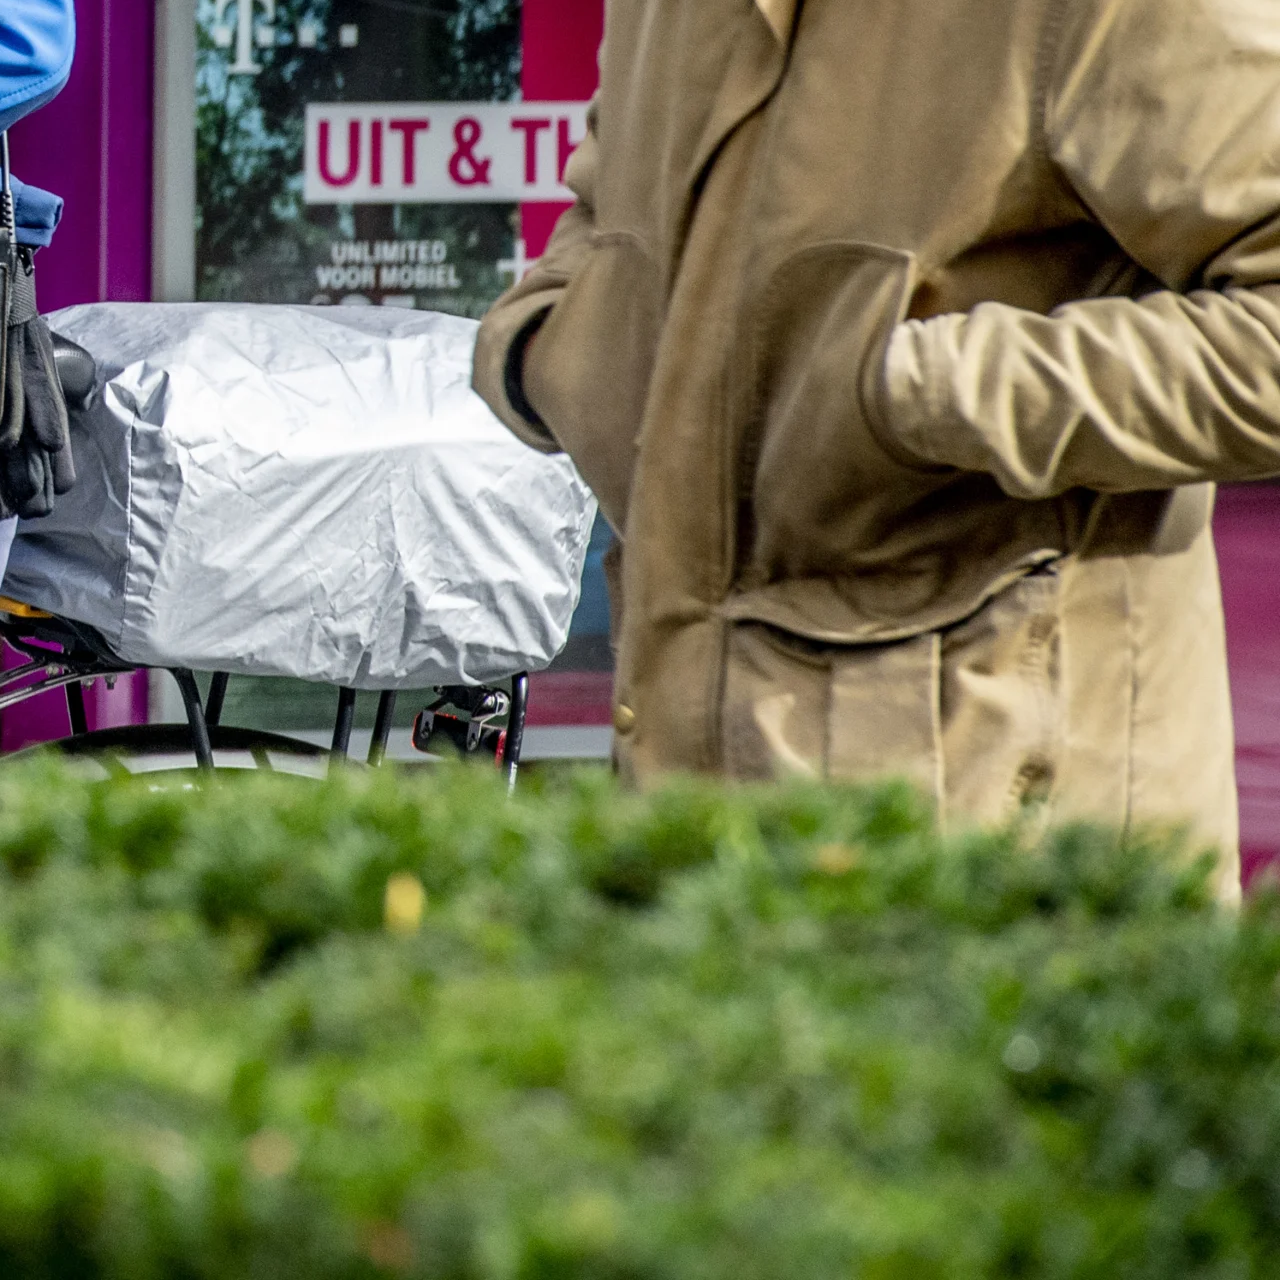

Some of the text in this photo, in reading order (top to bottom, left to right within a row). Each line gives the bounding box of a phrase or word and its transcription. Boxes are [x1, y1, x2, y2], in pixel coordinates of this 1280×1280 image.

[317, 118, 429, 188] UIT
[447, 116, 491, 186] &
[330, 239, 447, 264] UNLIMITED
[315, 264, 462, 289] VOOR MOBIEL
